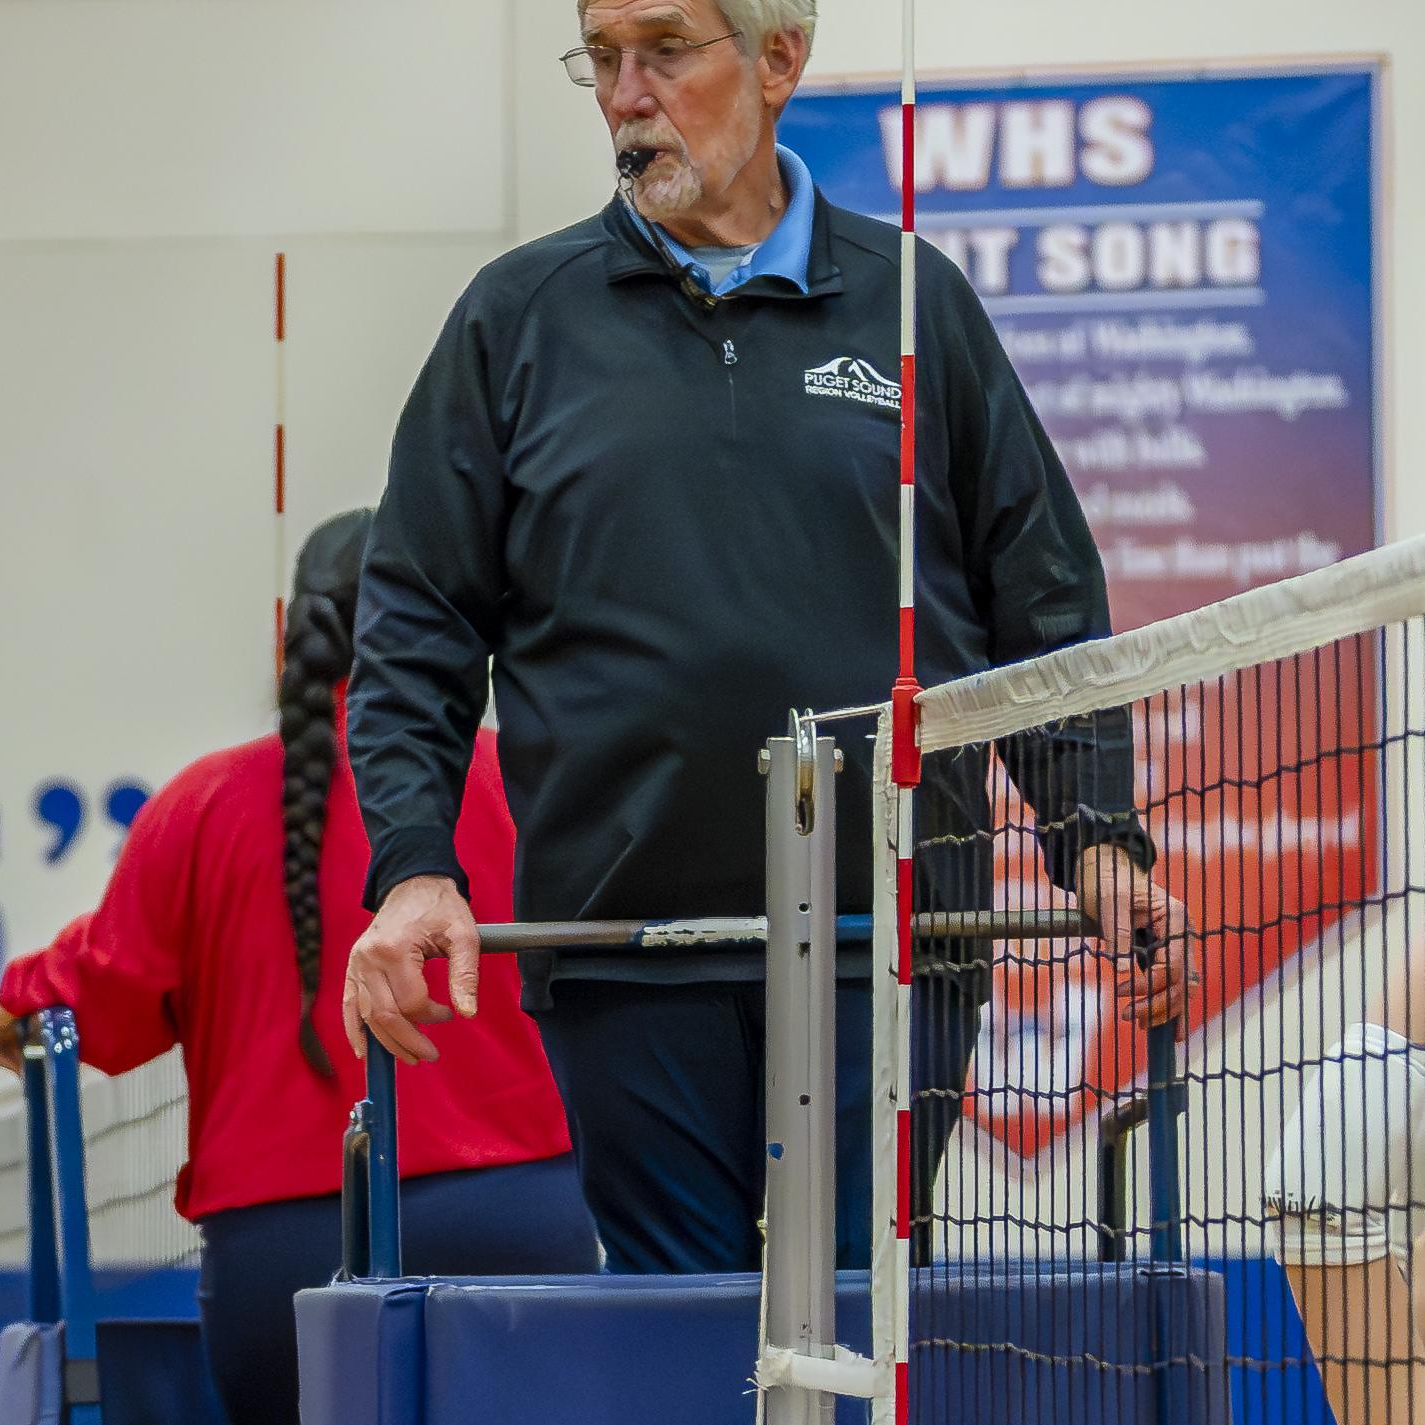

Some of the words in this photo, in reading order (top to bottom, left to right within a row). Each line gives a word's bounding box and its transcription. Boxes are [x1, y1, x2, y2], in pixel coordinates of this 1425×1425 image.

[880, 97, 1153, 193] WHS
[1035, 217, 1261, 291] SONG
[804, 373, 850, 389] PUGET
[851, 379, 902, 399] SOUND
[805, 385, 843, 398] REGION
